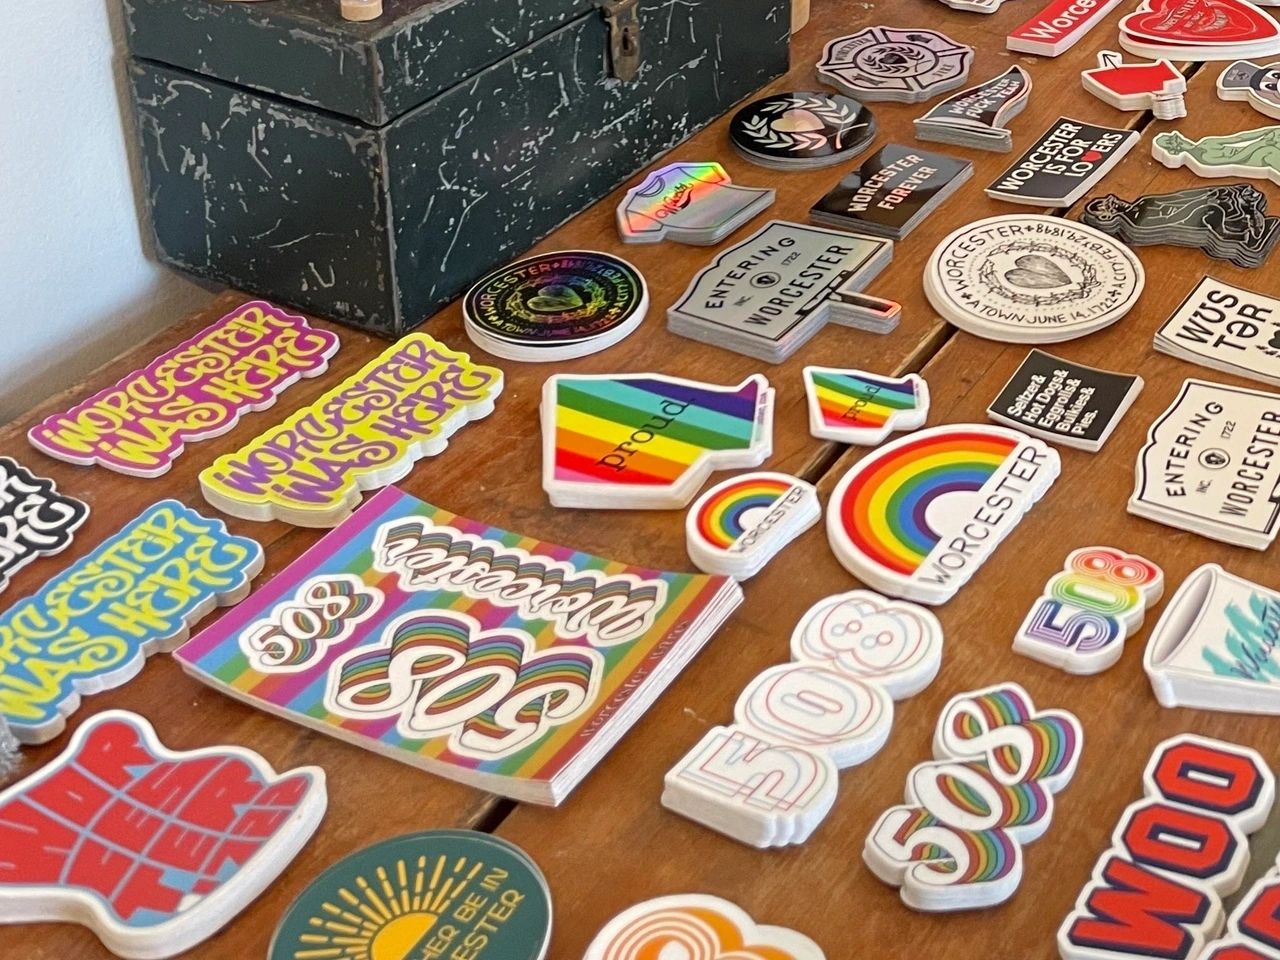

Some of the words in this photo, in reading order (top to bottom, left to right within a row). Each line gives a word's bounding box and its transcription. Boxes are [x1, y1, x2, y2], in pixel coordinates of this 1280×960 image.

[949, 76, 1011, 116] WORCESTER
[965, 96, 998, 121] FUCK
[993, 79, 1023, 101] YEAH
[846, 153, 926, 213] WORCESTER
[877, 164, 938, 210] FOREVER
[997, 122, 1084, 191] WORCESTER
[1042, 160, 1067, 176] IS
[1060, 138, 1093, 167] FOR
[480, 262, 551, 317] WORCESTER
[704, 236, 797, 310] ENTERING
[744, 243, 854, 328] WORCESTER
[781, 250, 802, 267] 1722
[946, 224, 1025, 292] WORCESTER
[503, 321, 538, 336] TOWN
[967, 299, 980, 310] A
[978, 304, 1025, 323] TOWN
[1024, 313, 1068, 325] JUNE
[43, 306, 284, 454] WORCESTER
[99, 399, 229, 466] WAS
[202, 326, 326, 405] HERE
[841, 384, 881, 422] proud
[1006, 374, 1047, 418] Seltzer&
[1022, 402, 1046, 424] Hot
[1035, 368, 1070, 405] Dogs&
[1037, 378, 1082, 428] Eggrolls&
[1055, 386, 1096, 433] Bulkies&
[215, 342, 457, 497] WORCESTER
[272, 437, 399, 505] WAS
[370, 362, 493, 442] HERE
[595, 398, 698, 474] proud
[1071, 409, 1099, 435] Pies.
[1165, 400, 1225, 500] ENTERING
[1221, 420, 1237, 441] 1722
[731, 484, 806, 555] WORCESTER
[917, 444, 1048, 587] WORCESTER
[0, 507, 210, 664] RCESTER
[98, 534, 248, 637] HERE
[1025, 550, 1158, 654] 508
[248, 580, 374, 666] 508
[336, 615, 594, 753] 508
[680, 596, 925, 812] 508
[868, 685, 1079, 894] 508
[1067, 740, 1264, 960] WOO
[456, 893, 490, 924] BE
[479, 867, 510, 892] IN
